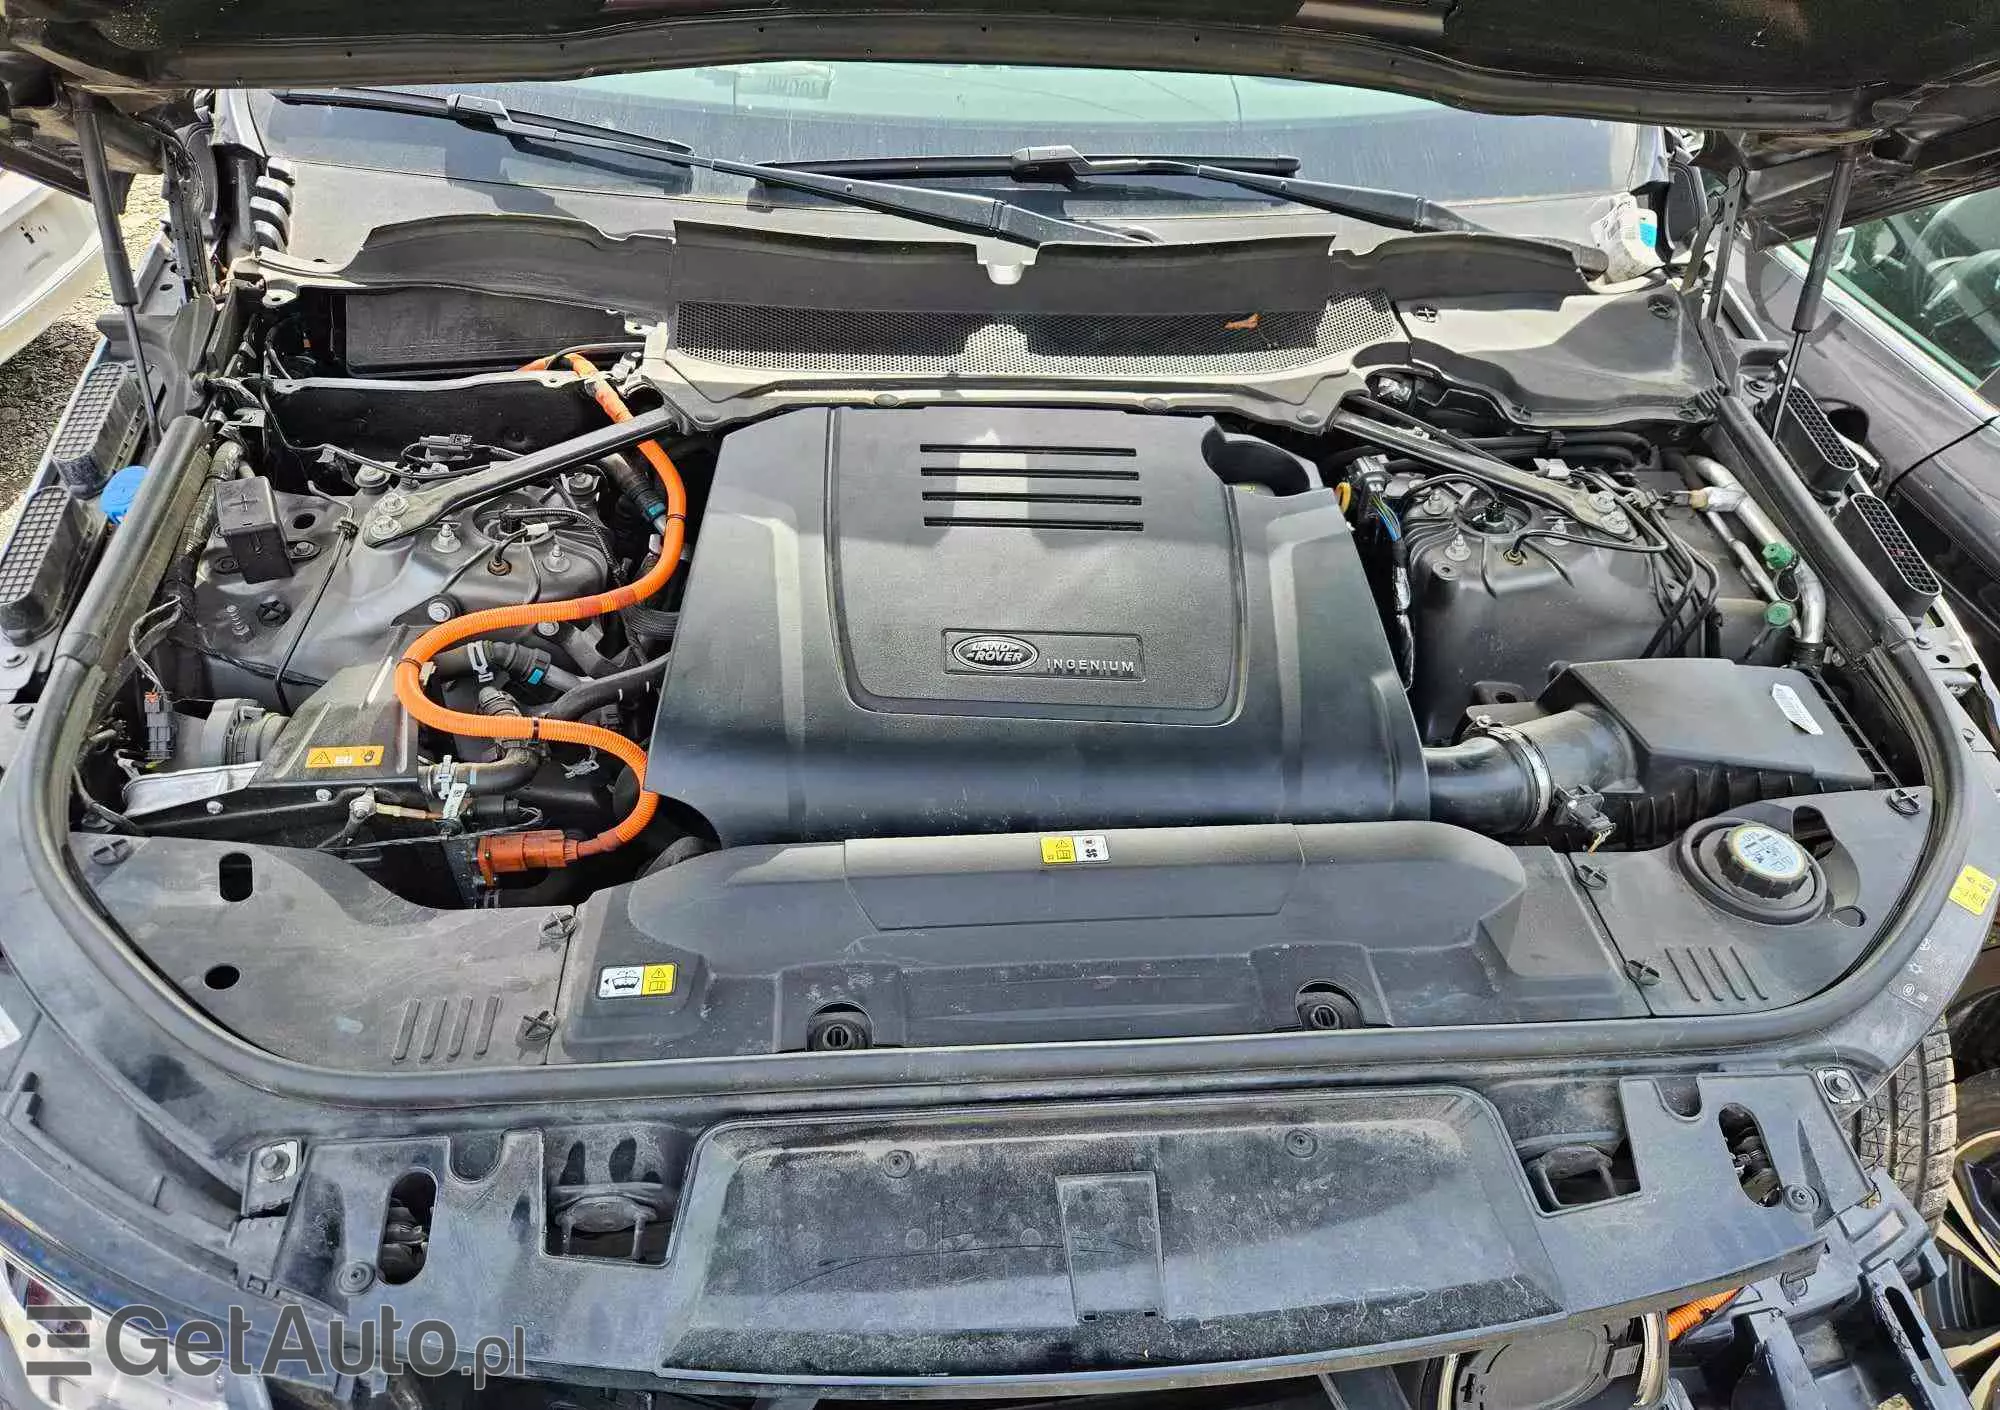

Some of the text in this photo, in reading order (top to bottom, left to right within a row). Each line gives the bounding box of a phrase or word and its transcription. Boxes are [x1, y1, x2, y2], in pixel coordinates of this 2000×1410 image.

[972, 641, 1010, 651] LAND
[974, 650, 1024, 662] ROVER
[1047, 658, 1134, 672] INGENIUM
